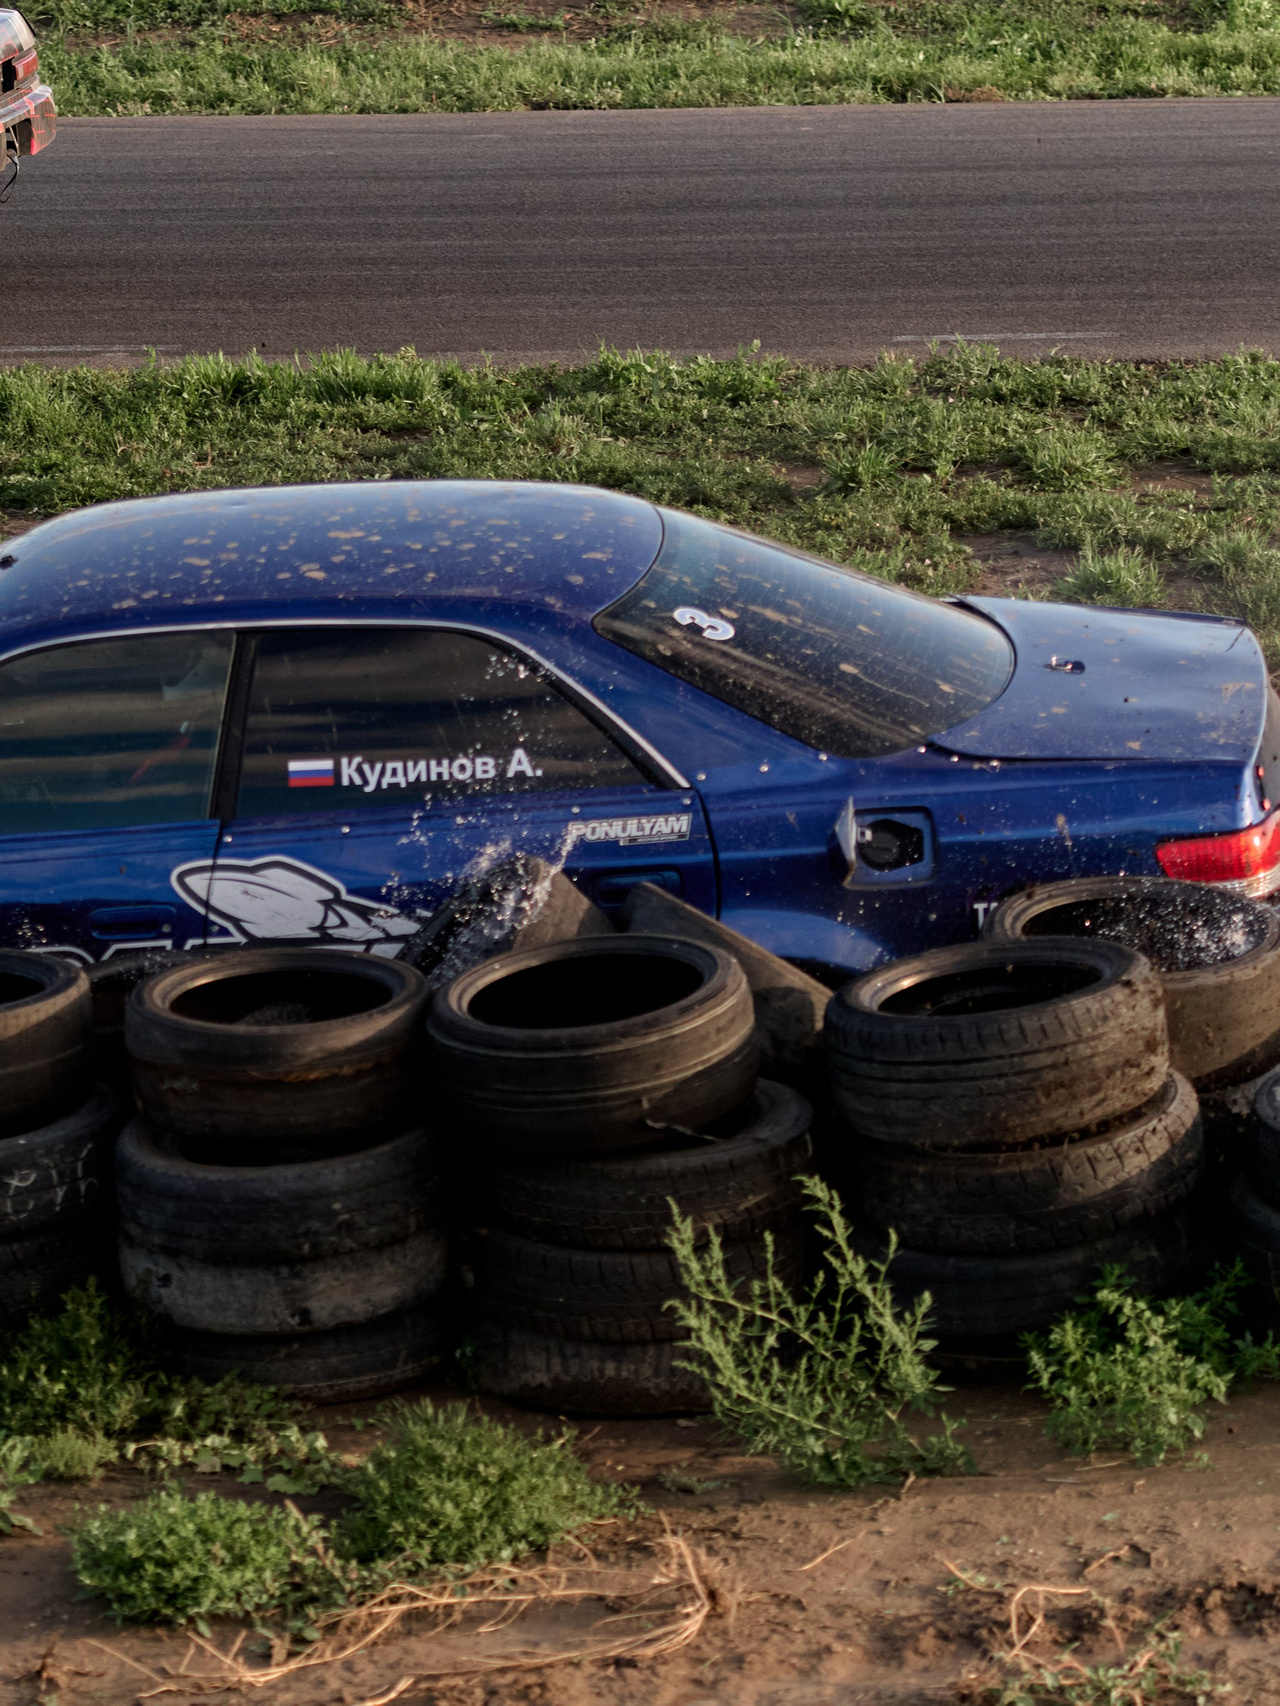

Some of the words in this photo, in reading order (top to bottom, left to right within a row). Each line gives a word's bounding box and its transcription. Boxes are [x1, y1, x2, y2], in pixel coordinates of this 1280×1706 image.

[672, 607, 736, 641] 3
[340, 756, 496, 793] Кудинов
[506, 748, 543, 777] А.
[570, 815, 689, 841] PONULYAM
